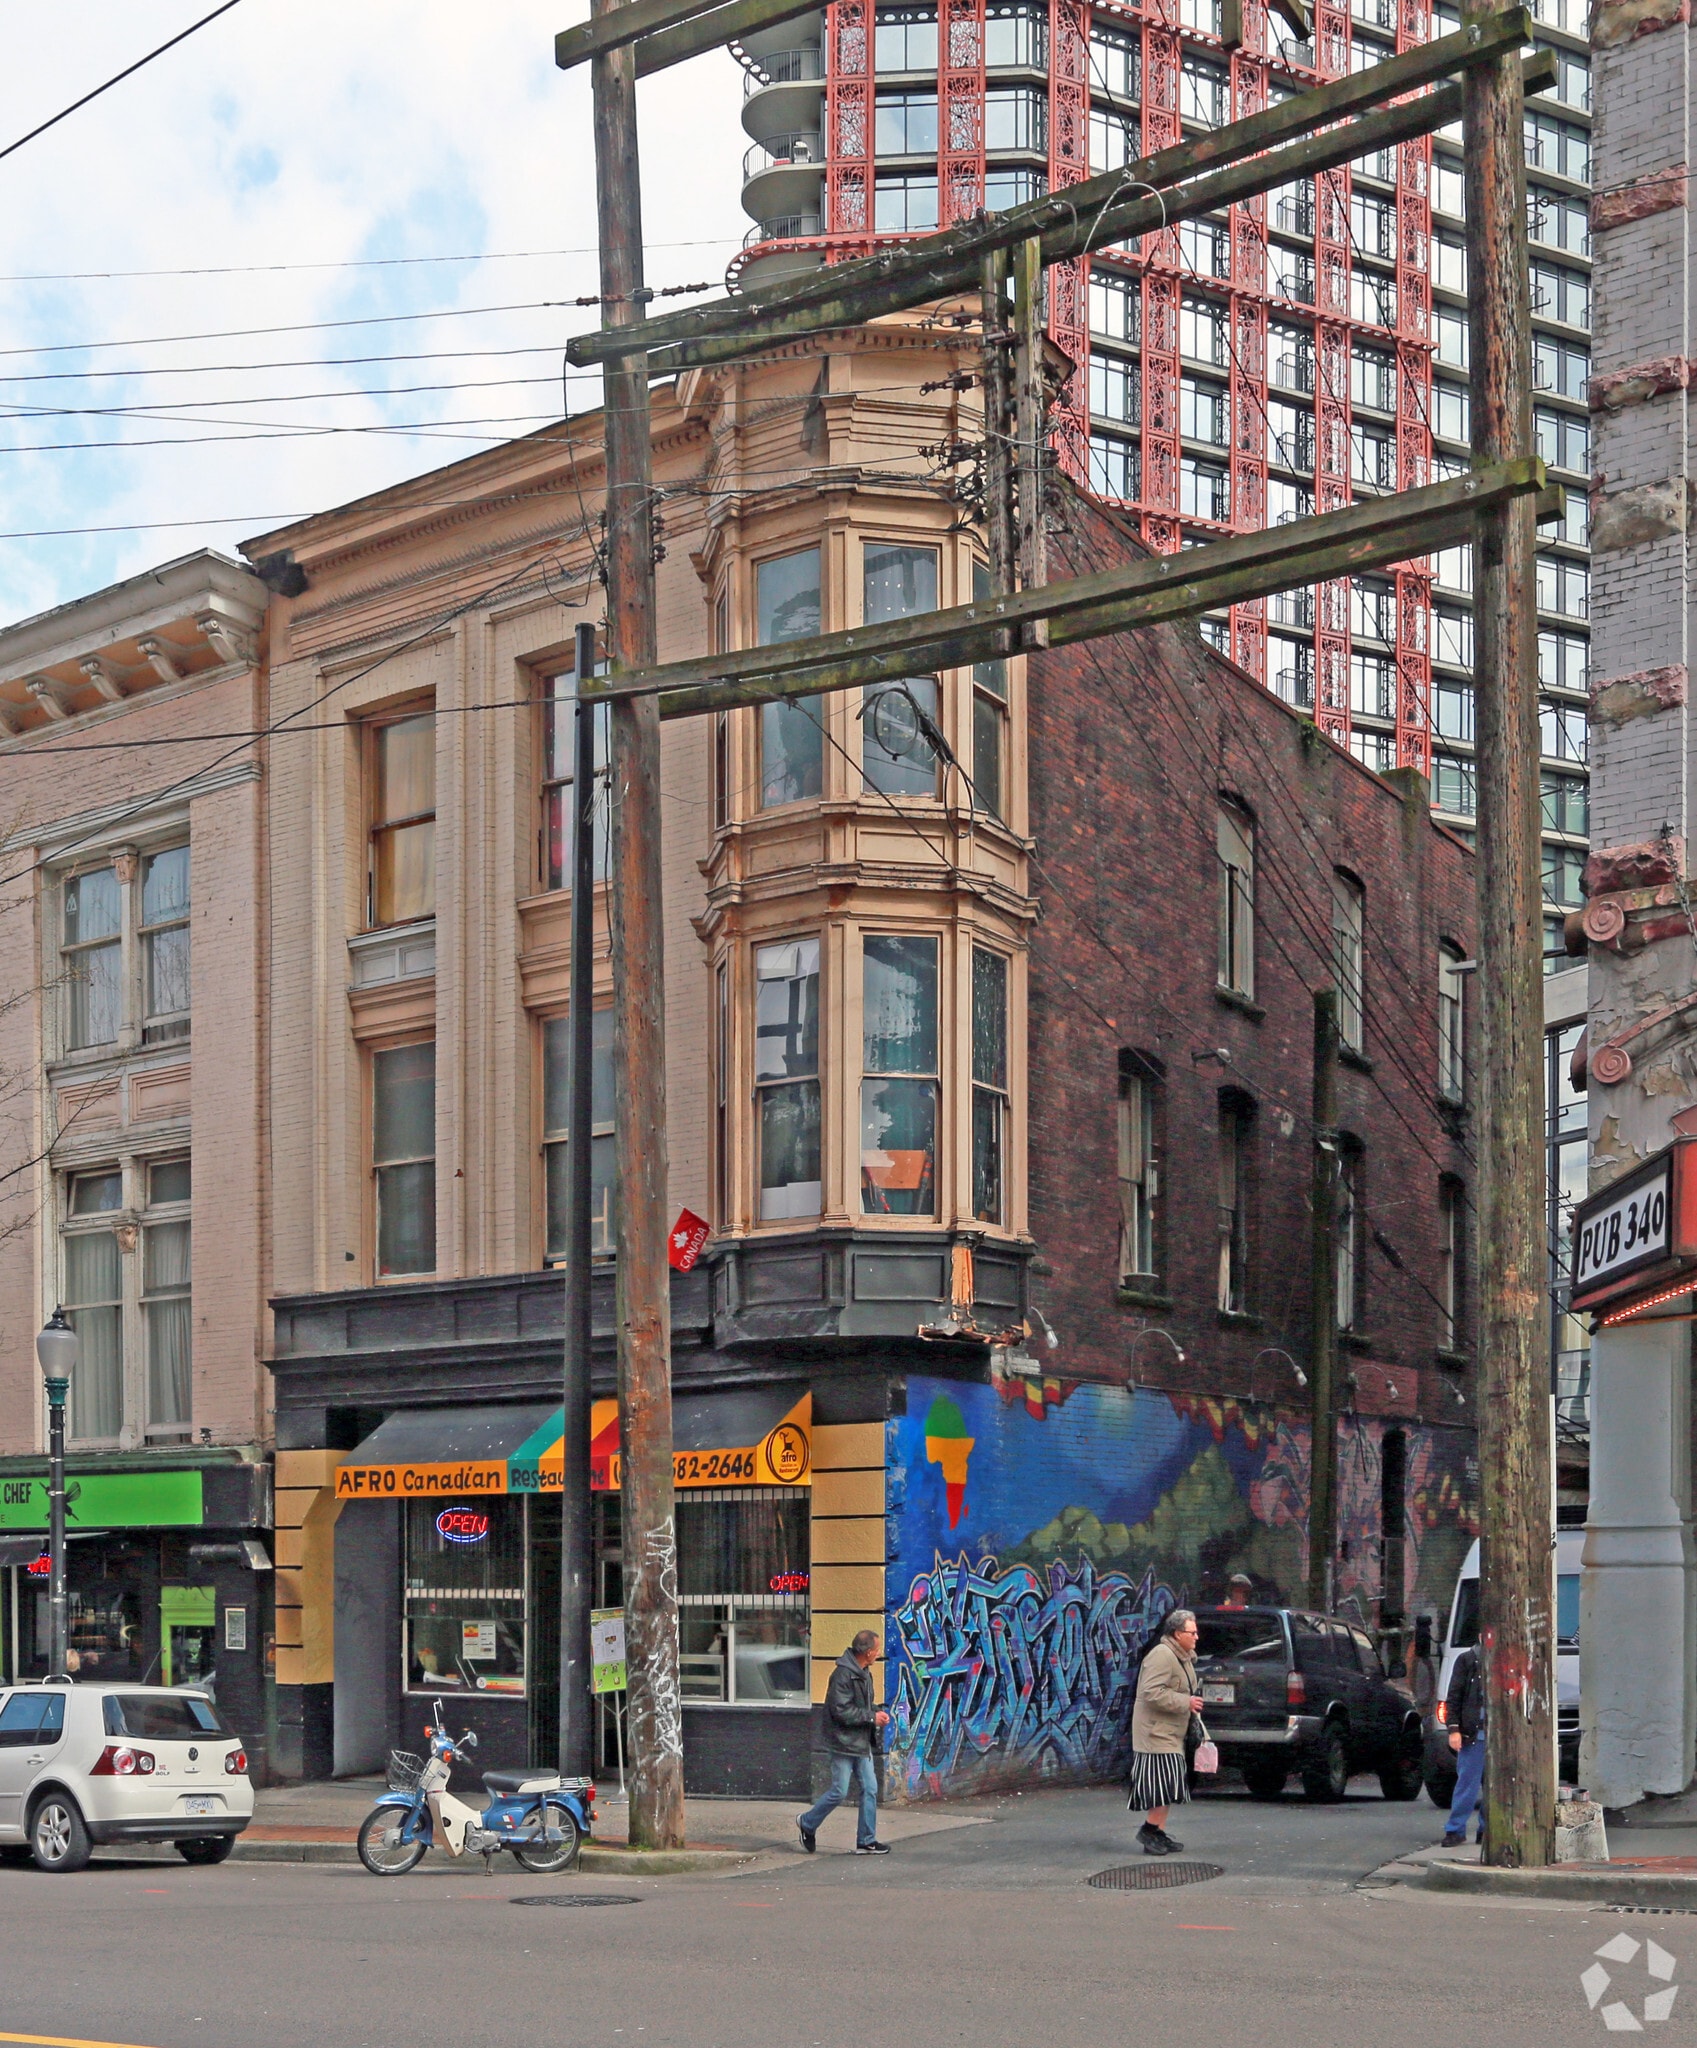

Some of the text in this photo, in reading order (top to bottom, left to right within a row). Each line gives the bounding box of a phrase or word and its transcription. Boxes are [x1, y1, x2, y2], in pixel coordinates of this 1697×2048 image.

[1580, 1190, 1665, 1277] PUB 340
[680, 1227, 708, 1269] CANADA
[781, 1452, 797, 1463] afro
[338, 1469, 396, 1493] AFRO
[402, 1466, 501, 1491] Canadian
[511, 1467, 605, 1489] Restaunt
[4, 1482, 32, 1504] CHEF
[439, 1513, 489, 1533] OPEN
[770, 1575, 809, 1591] OPEN
